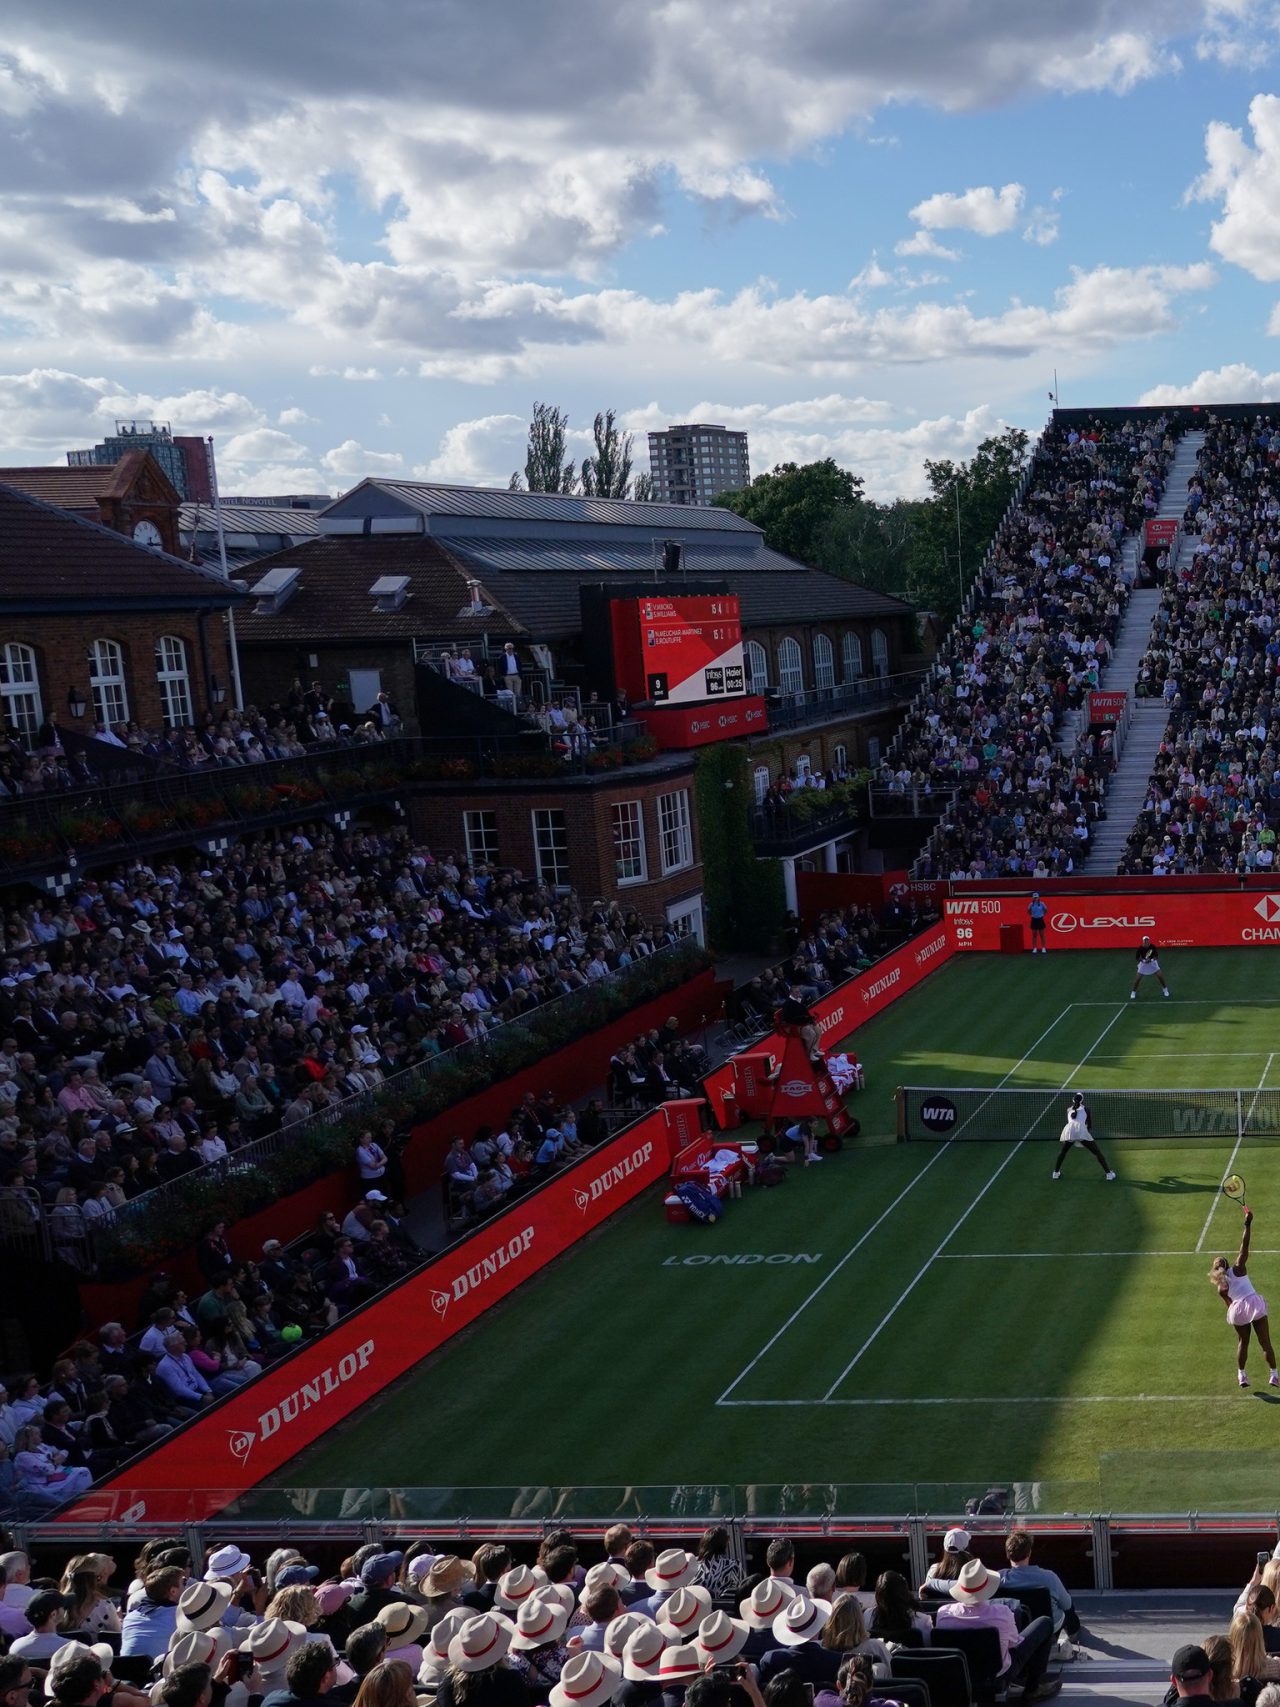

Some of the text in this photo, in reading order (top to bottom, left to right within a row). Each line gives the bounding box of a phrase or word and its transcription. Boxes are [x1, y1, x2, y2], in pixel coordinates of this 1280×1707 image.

[242, 498, 277, 506] NOVOTEL
[655, 679, 661, 689] 9
[911, 883, 936, 891] HSBC
[946, 900, 1001, 914] WTA 500
[1080, 916, 1156, 928] LEXUS
[956, 928, 973, 939] 96
[920, 935, 946, 962] DUNLOP
[869, 967, 900, 999] DUNLOP
[816, 1007, 845, 1034] NLOP
[923, 1107, 954, 1120] WTA
[1173, 1108, 1237, 1131] WTA
[591, 1141, 653, 1200] DUNLOP
[451, 1226, 535, 1302] DUNLOP
[661, 1253, 823, 1265] LONDON
[257, 1339, 375, 1441] DUNLOP
